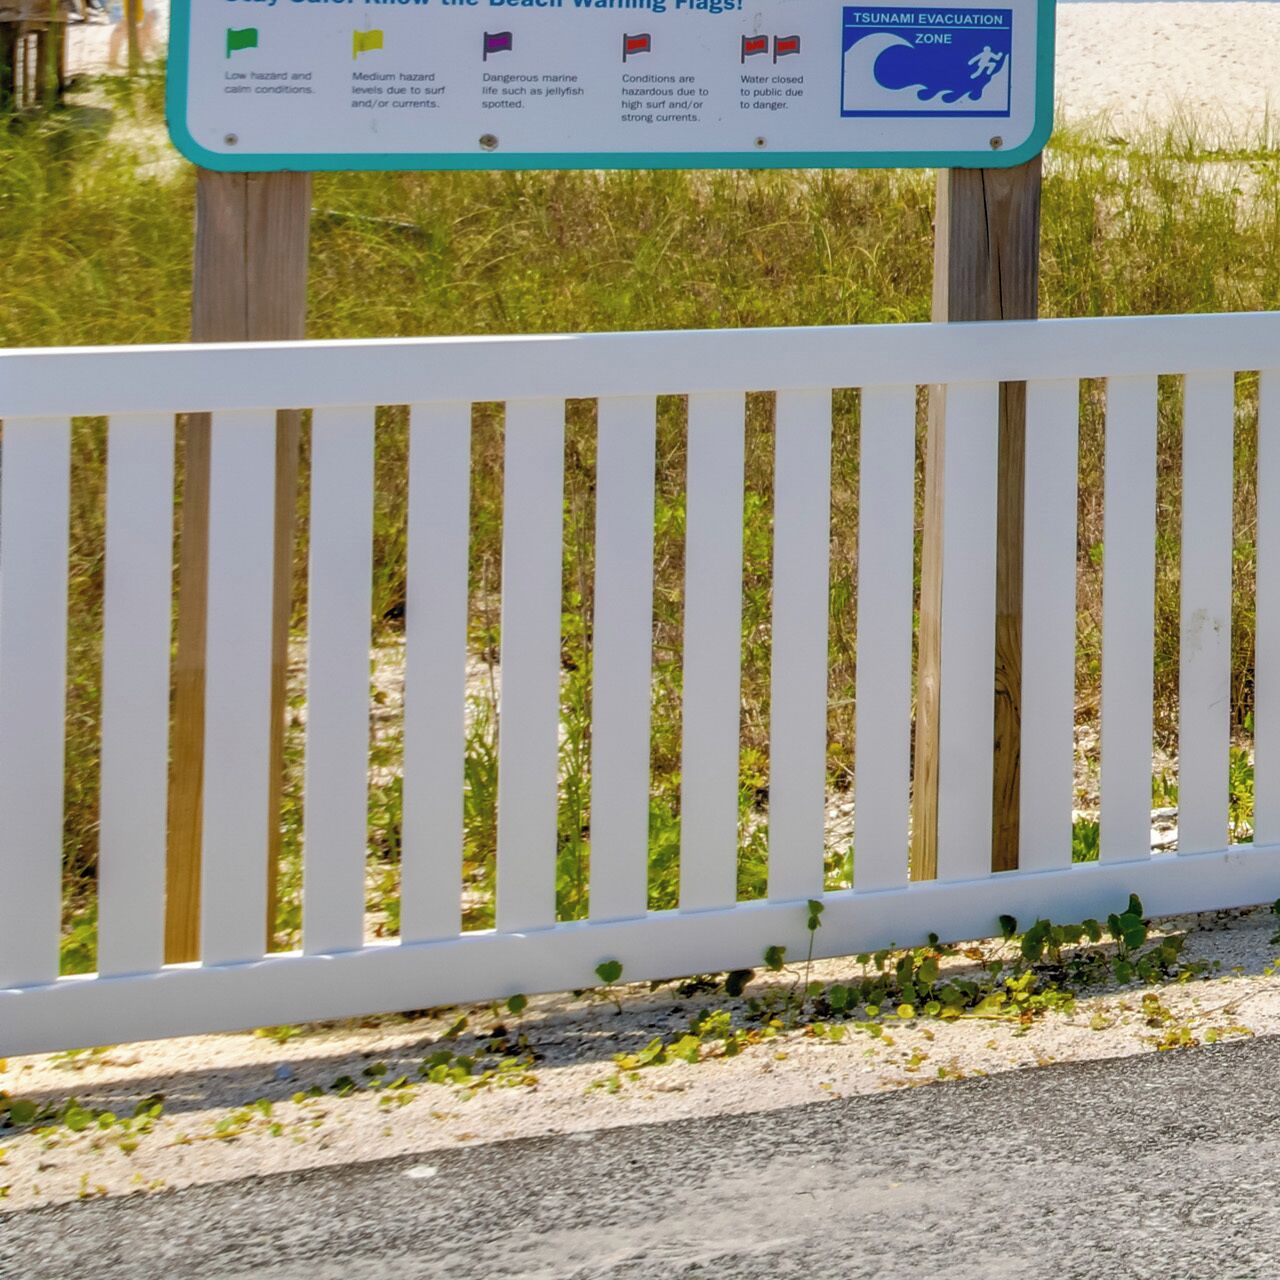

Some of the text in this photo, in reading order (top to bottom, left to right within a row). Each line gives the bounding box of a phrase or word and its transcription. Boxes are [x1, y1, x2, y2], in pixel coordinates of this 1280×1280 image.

[854, 12, 1004, 25] TSUNAMI EVACUATION
[915, 33, 952, 45] ZONE
[225, 71, 312, 80] Low hazard and
[352, 73, 435, 81] Medium hazard
[483, 73, 539, 84] Dangerous
[622, 74, 675, 83] Conditions
[741, 75, 804, 84] Water closed
[224, 86, 316, 94] calm conditions.
[352, 86, 383, 94] levels
[425, 86, 446, 94] surf
[482, 87, 498, 95] life
[502, 87, 526, 95] such
[545, 87, 584, 97] jellyfish
[622, 88, 708, 96] hazardous due to
[740, 88, 803, 97] to public due
[352, 100, 440, 109] and/or currents.
[482, 100, 525, 109] spotted.
[621, 101, 703, 110] high surf and/or
[740, 101, 788, 110] to danger.
[621, 114, 700, 123] strong currents.
